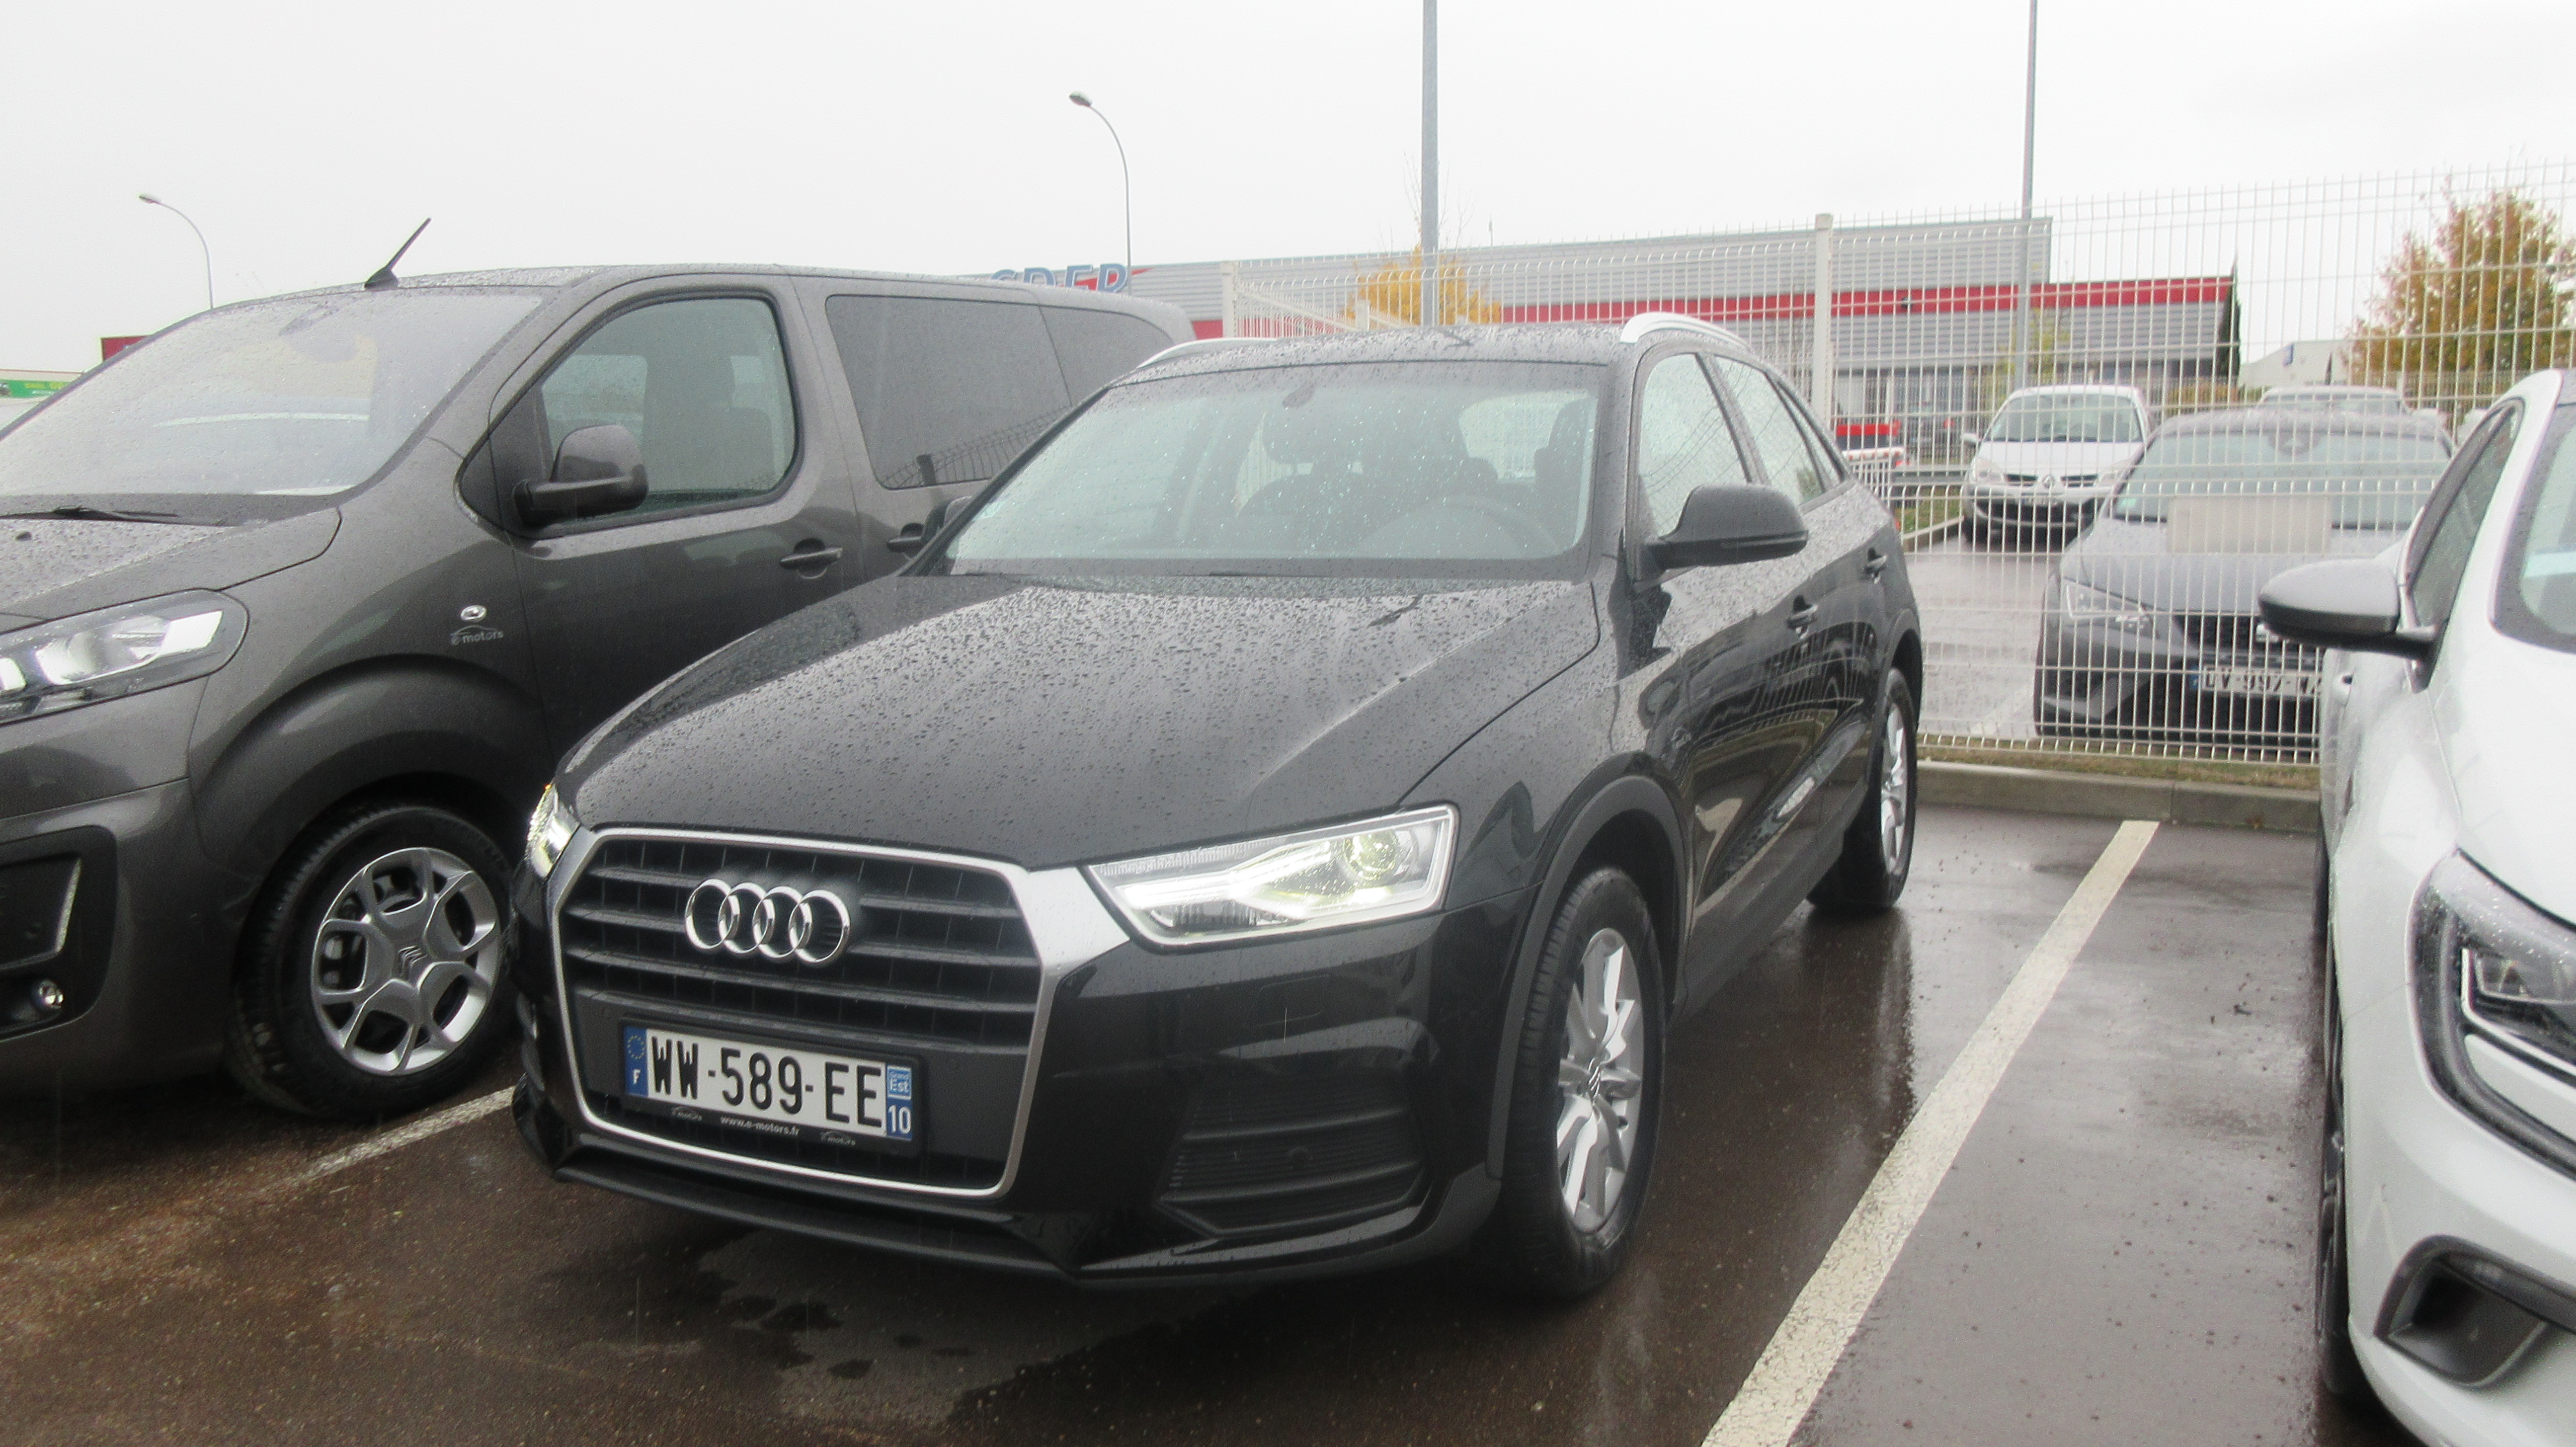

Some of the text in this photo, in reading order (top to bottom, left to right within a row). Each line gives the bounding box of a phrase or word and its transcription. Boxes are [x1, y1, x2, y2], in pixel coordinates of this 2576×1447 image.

[633, 1069, 641, 1084] F
[652, 1036, 882, 1127] WW-589-EE
[888, 1105, 911, 1134] 10
